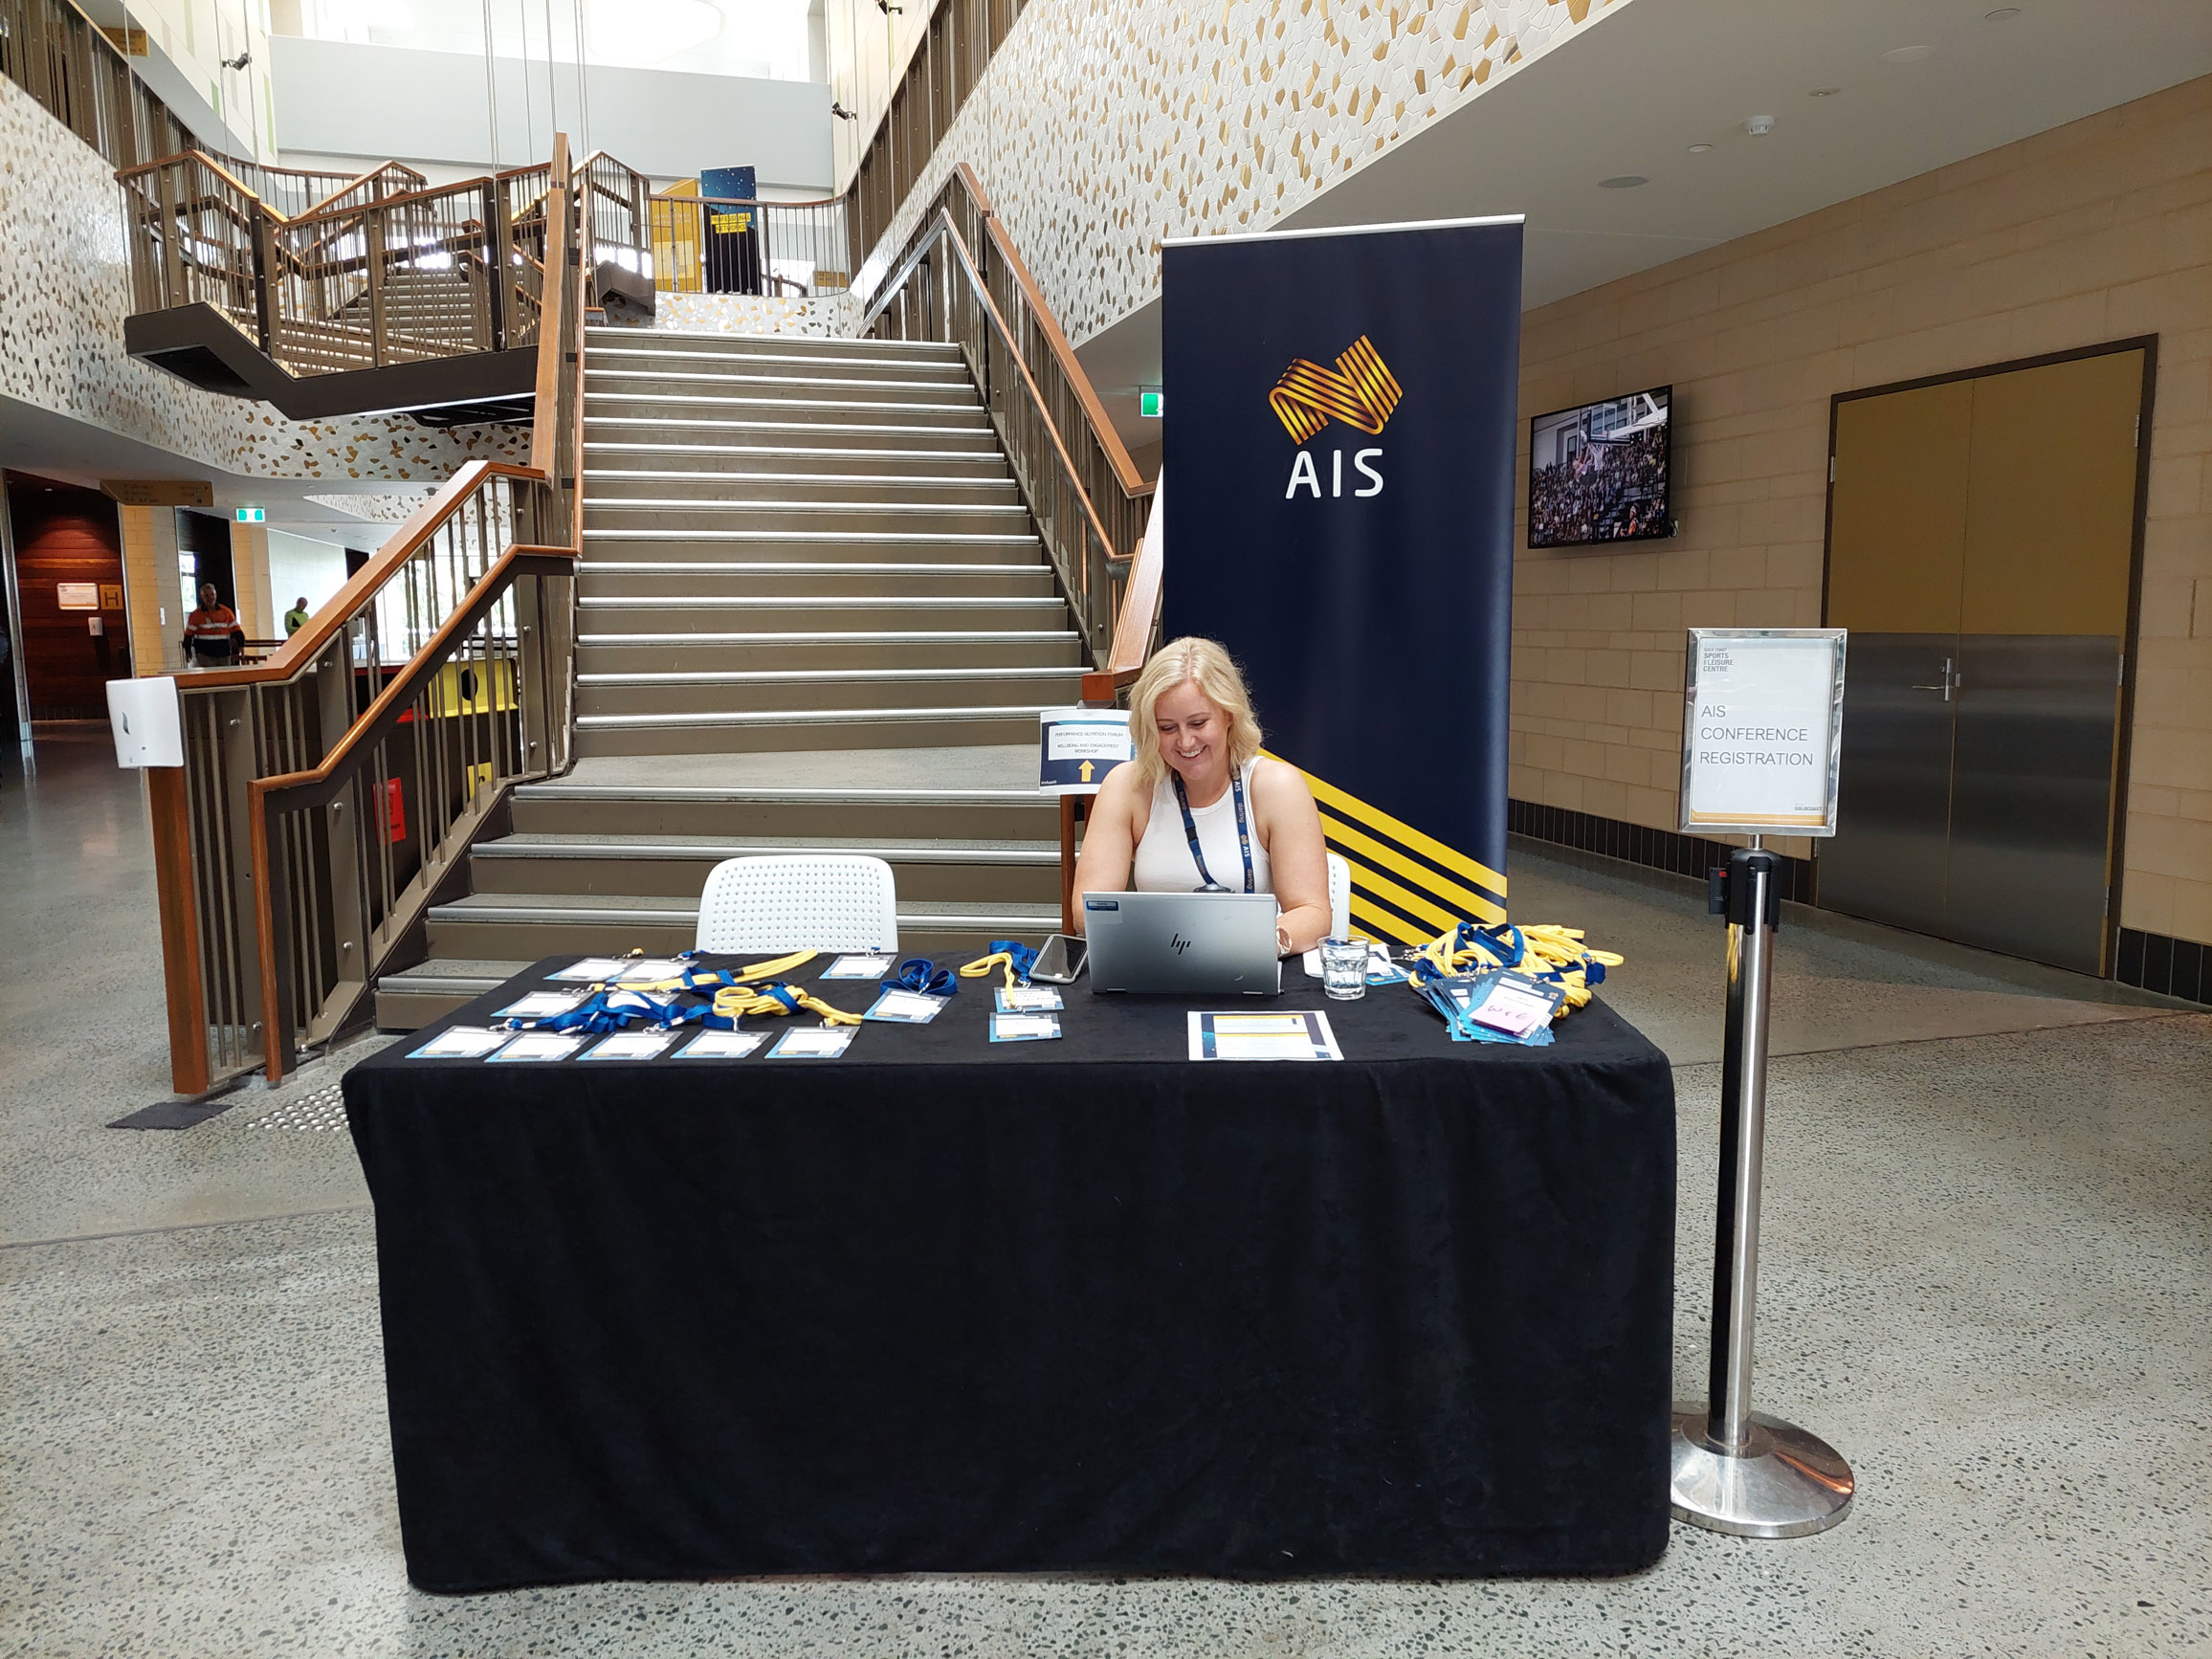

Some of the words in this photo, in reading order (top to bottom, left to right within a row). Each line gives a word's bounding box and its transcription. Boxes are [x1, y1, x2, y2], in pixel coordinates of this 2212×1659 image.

[1285, 448, 1384, 499] AIS
[1701, 704, 1726, 718] AIS
[1700, 727, 1808, 741] CONFERENCE
[1699, 751, 1814, 766] REGISTRATION
